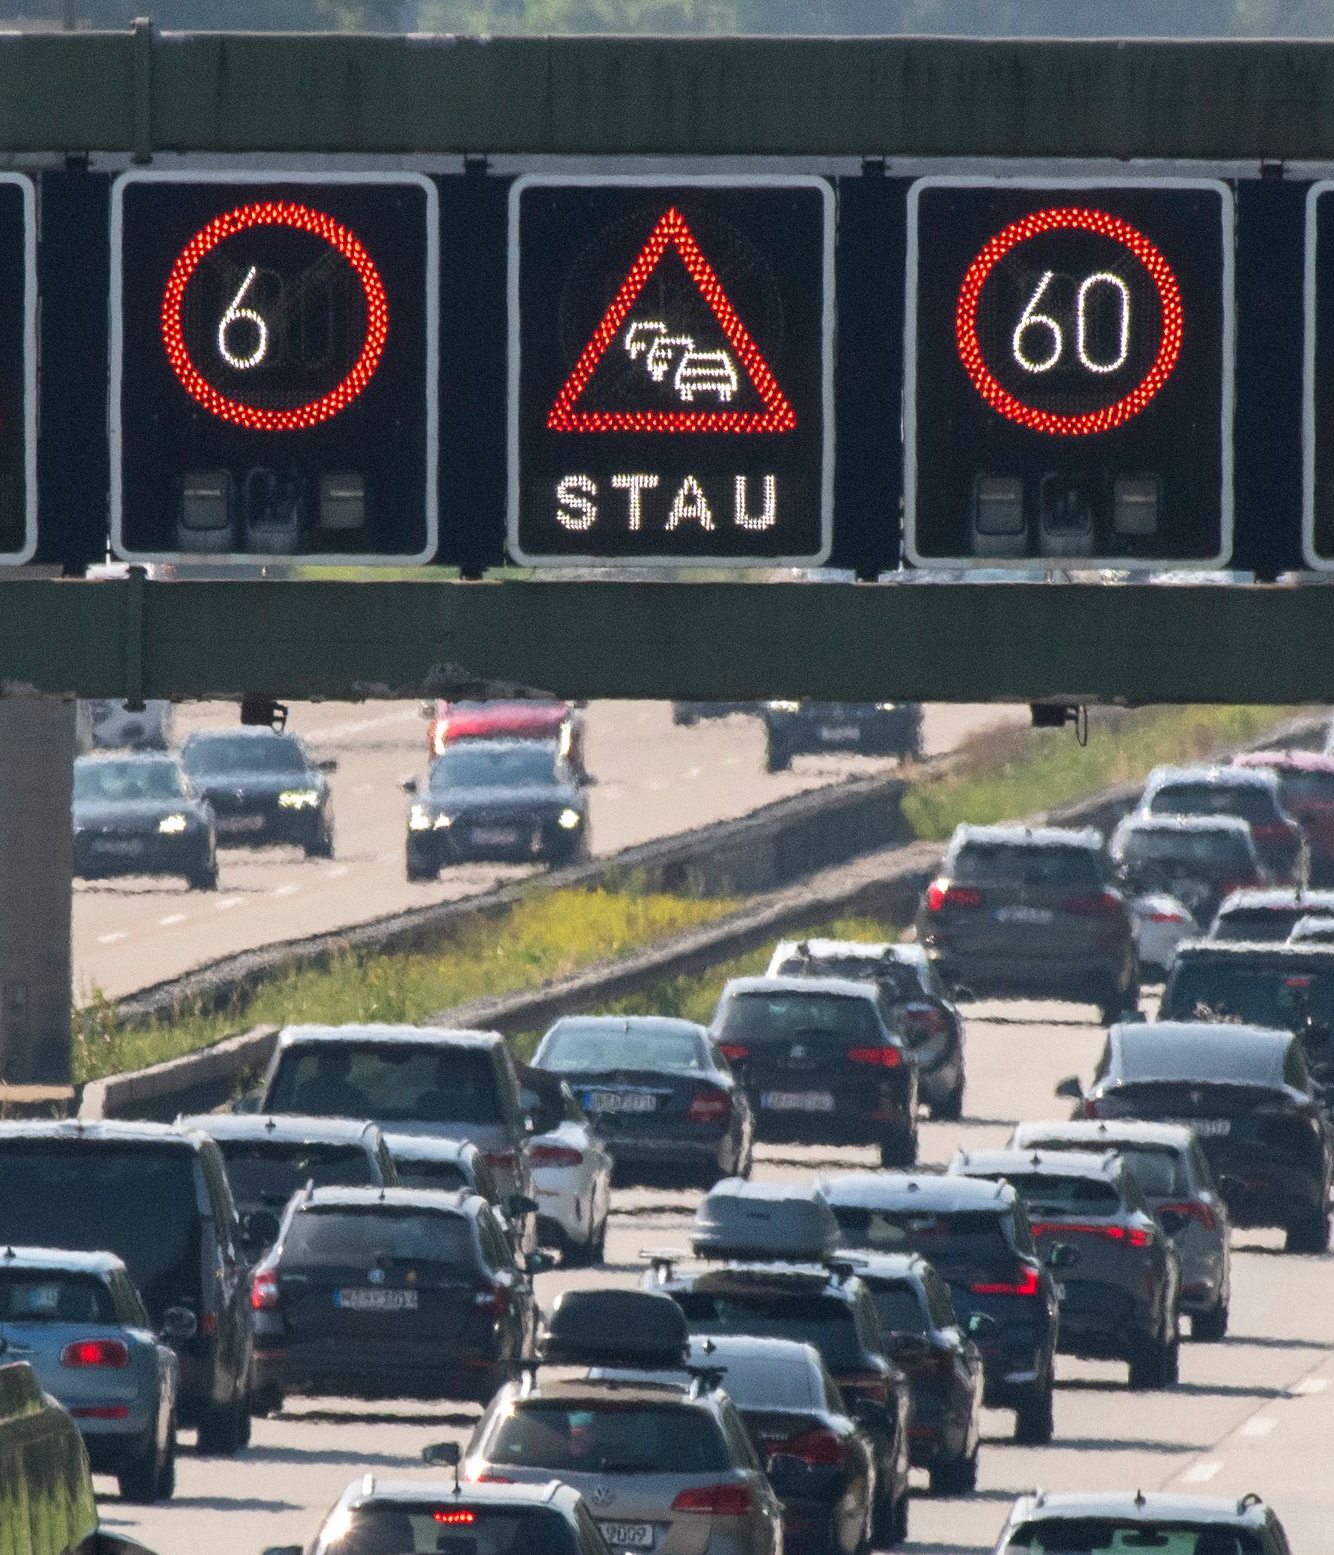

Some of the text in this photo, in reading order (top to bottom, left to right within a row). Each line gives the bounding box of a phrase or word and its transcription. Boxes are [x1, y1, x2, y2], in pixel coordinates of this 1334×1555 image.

[217, 265, 268, 369] 6
[1010, 270, 1131, 374] 60
[555, 473, 778, 532] STAU
